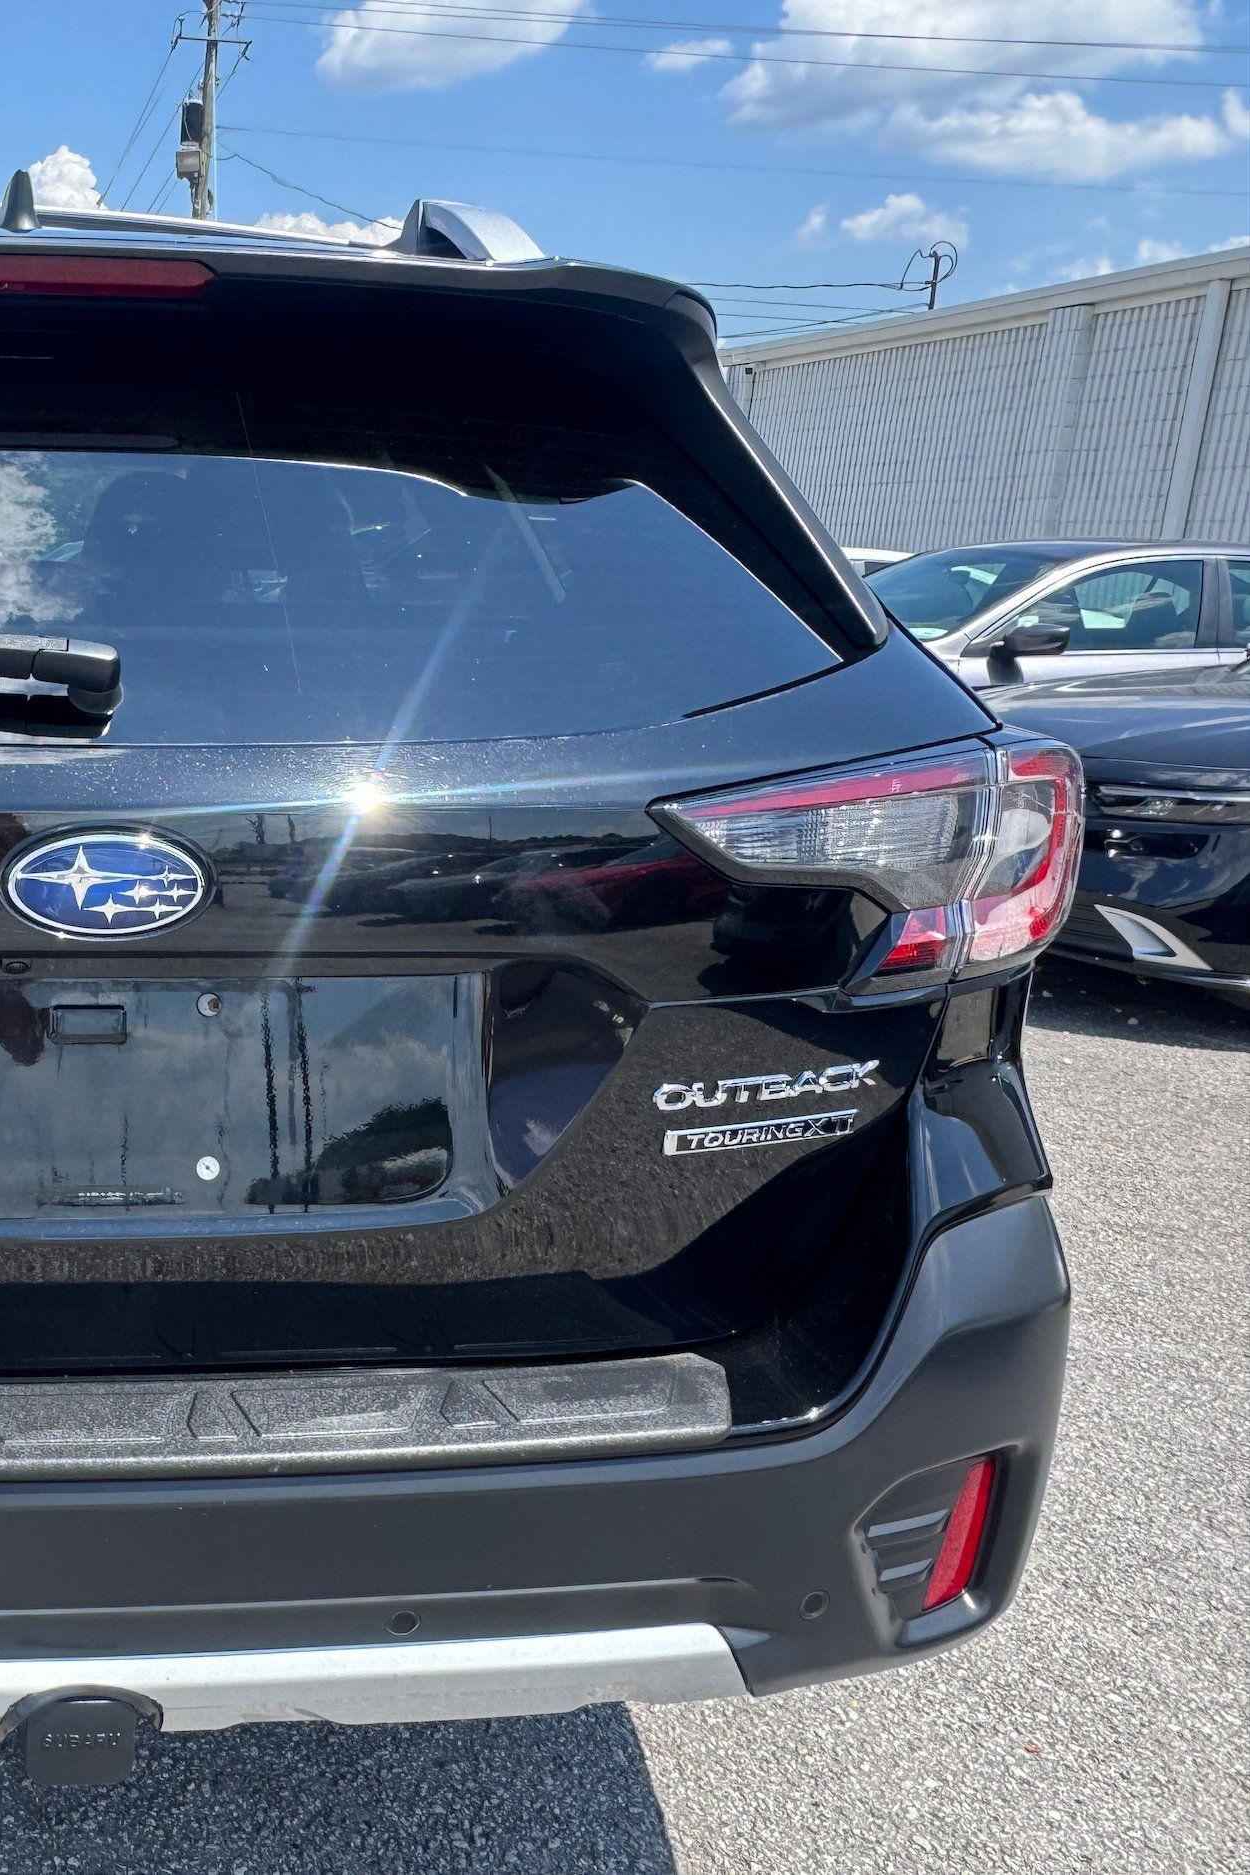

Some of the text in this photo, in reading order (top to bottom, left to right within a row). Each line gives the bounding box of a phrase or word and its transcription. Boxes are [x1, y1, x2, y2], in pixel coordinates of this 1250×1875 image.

[652, 1059, 880, 1111] OUTBACK
[687, 1123, 805, 1149] TOURING
[43, 1731, 123, 1749] SUBARU
